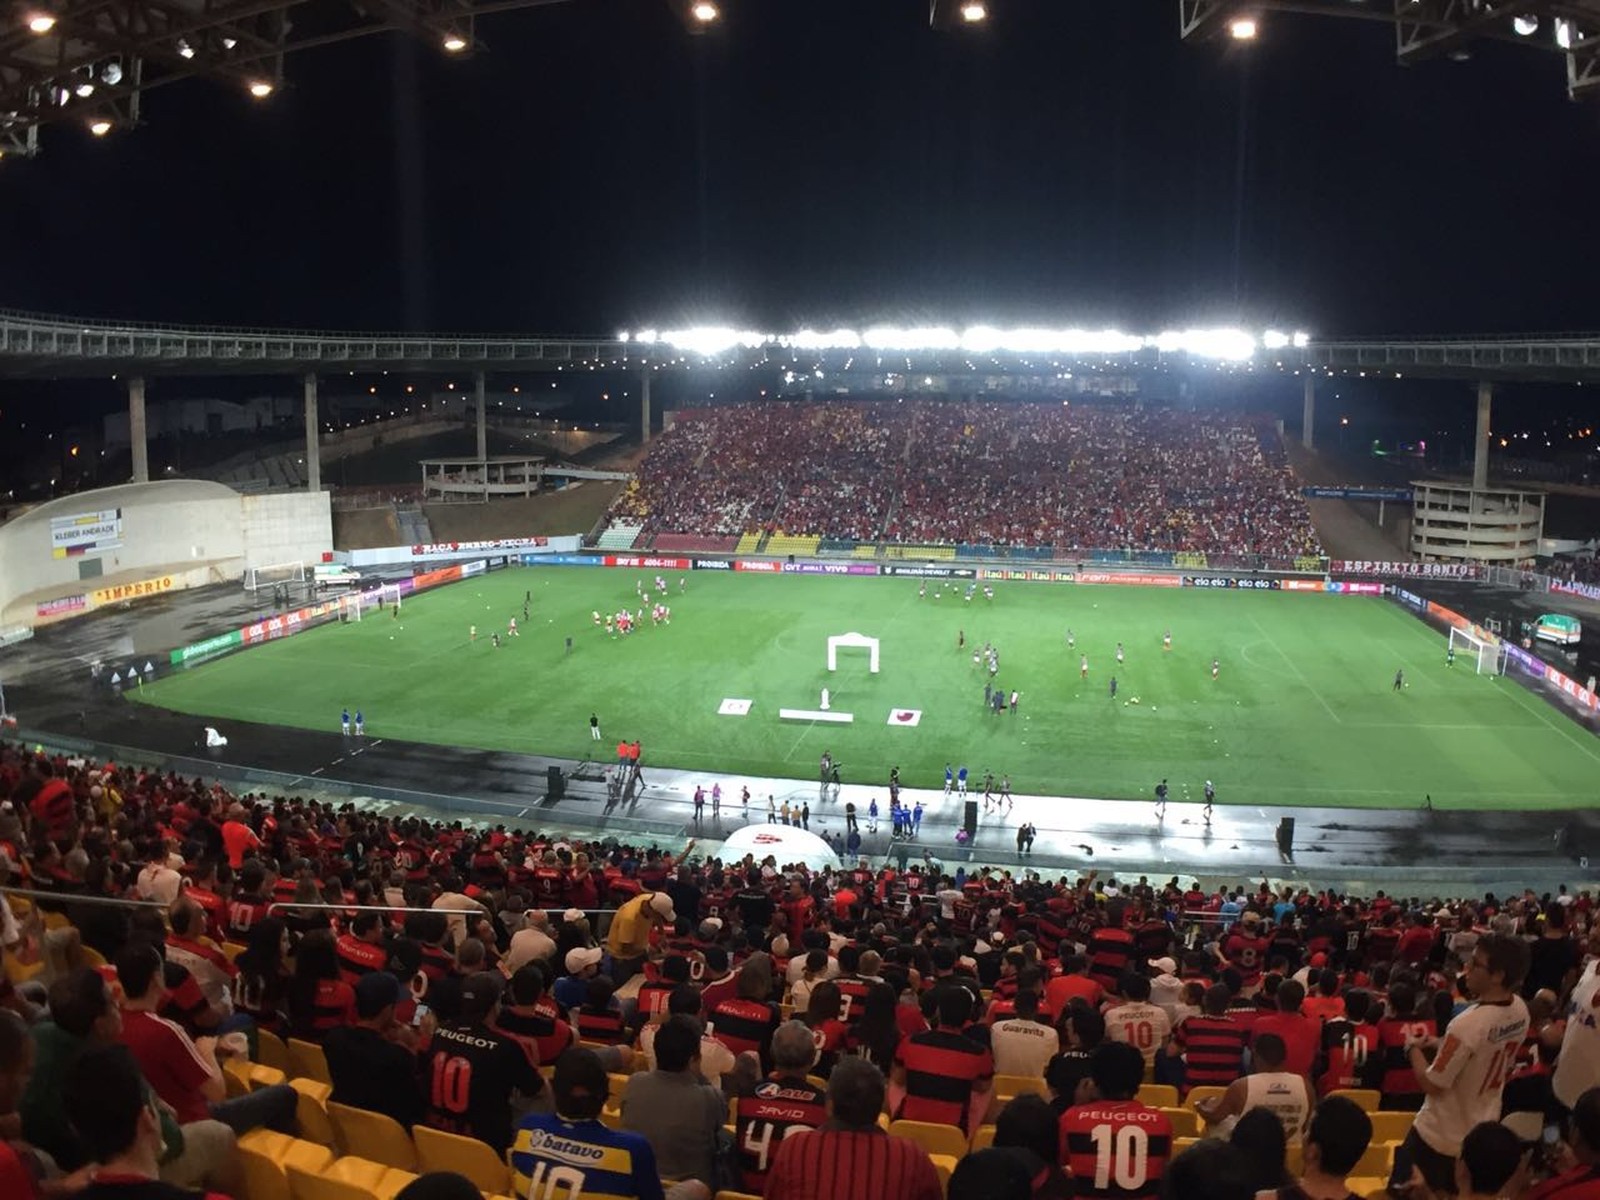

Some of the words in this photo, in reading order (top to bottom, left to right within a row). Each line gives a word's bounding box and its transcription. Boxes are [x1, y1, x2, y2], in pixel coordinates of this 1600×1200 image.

[55, 529, 80, 541] KLEBER
[82, 524, 114, 536] ANDRADE
[1423, 563, 1468, 577] SANTO
[230, 903, 253, 932] 10
[1119, 1010, 1154, 1020] PEUGEOT
[435, 1027, 498, 1050] PEUGEOT
[1002, 1022, 1045, 1037] Guaravita
[1124, 1020, 1153, 1049] 10
[1341, 1031, 1368, 1067] 10
[430, 1051, 472, 1114] 10
[1078, 1110, 1158, 1123] PEUGEOT
[543, 1135, 604, 1160] batavo
[1090, 1123, 1149, 1191] 10
